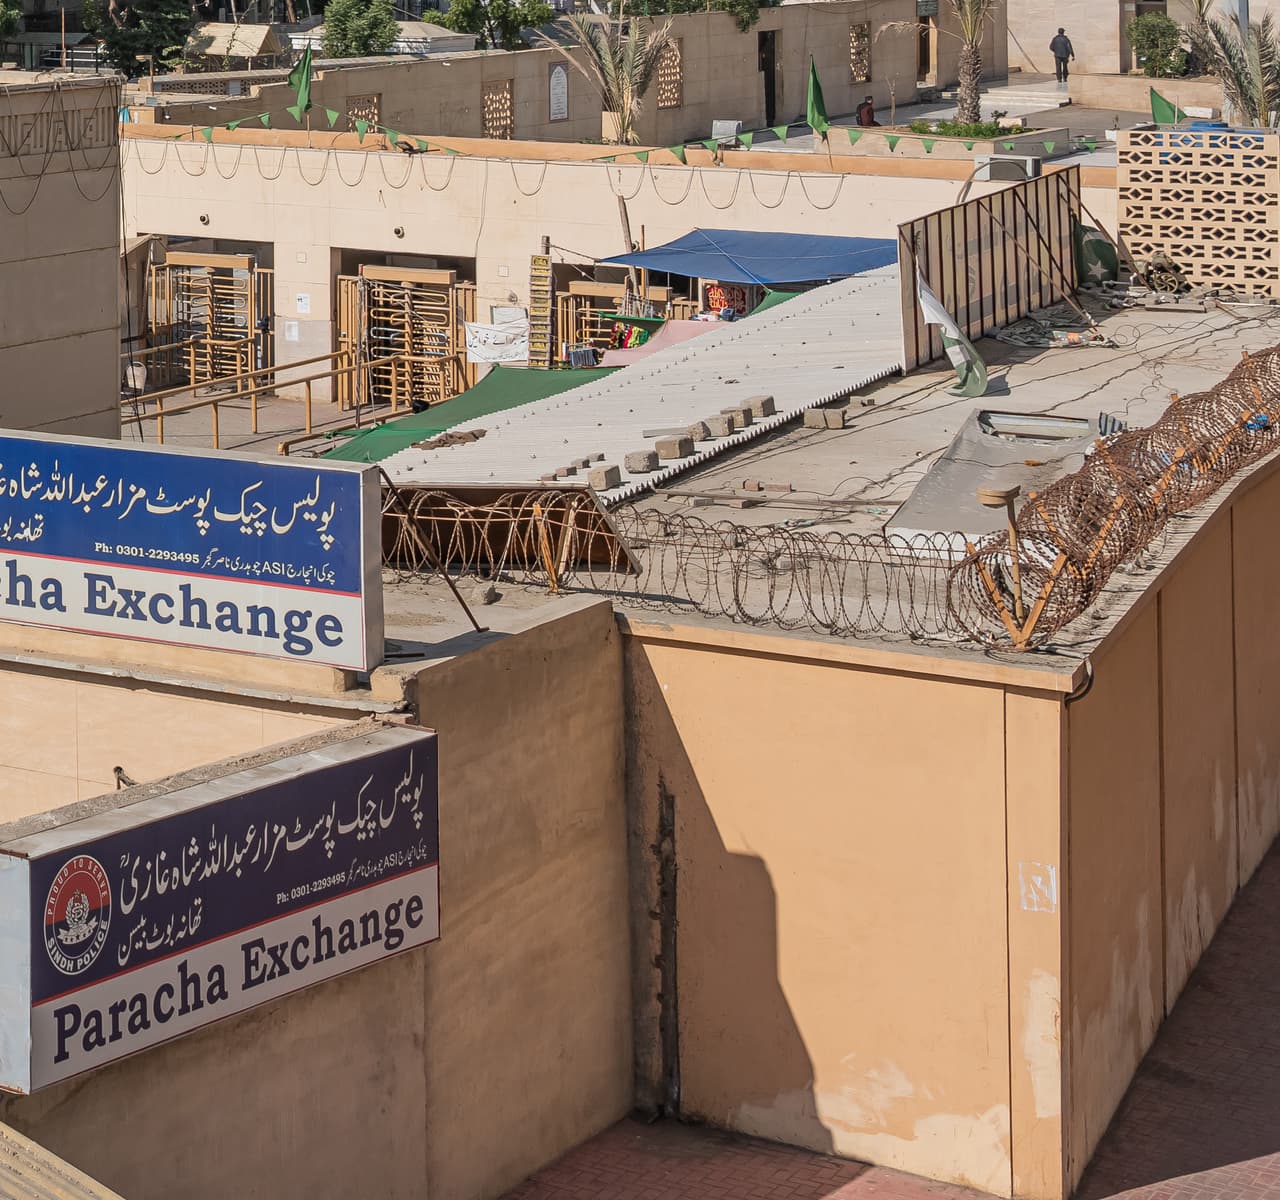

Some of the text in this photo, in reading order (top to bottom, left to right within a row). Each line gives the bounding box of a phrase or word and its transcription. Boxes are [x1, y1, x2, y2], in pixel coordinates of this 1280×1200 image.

[9, 462, 43, 500] شاہ
[101, 478, 146, 520] مزار
[146, 486, 211, 537] پوسٹ
[213, 480, 268, 537] چیک
[271, 474, 336, 550] پولیس
[95, 542, 200, 564] Ph: 0301-2293495
[262, 561, 285, 575] ASI
[83, 571, 345, 657] Exchange
[338, 774, 377, 841] چیک
[379, 748, 424, 830] پولیس
[250, 820, 287, 873] مزار
[286, 800, 336, 860] پوسٹ
[47, 858, 108, 916] PROUD TO SERVE
[171, 836, 202, 891] شاہ
[383, 852, 398, 869] ASI
[276, 871, 346, 905] Ph: 0301-2293495
[48, 920, 108, 972] SINDH POLICE
[53, 895, 424, 1064] Paracha Exchange
